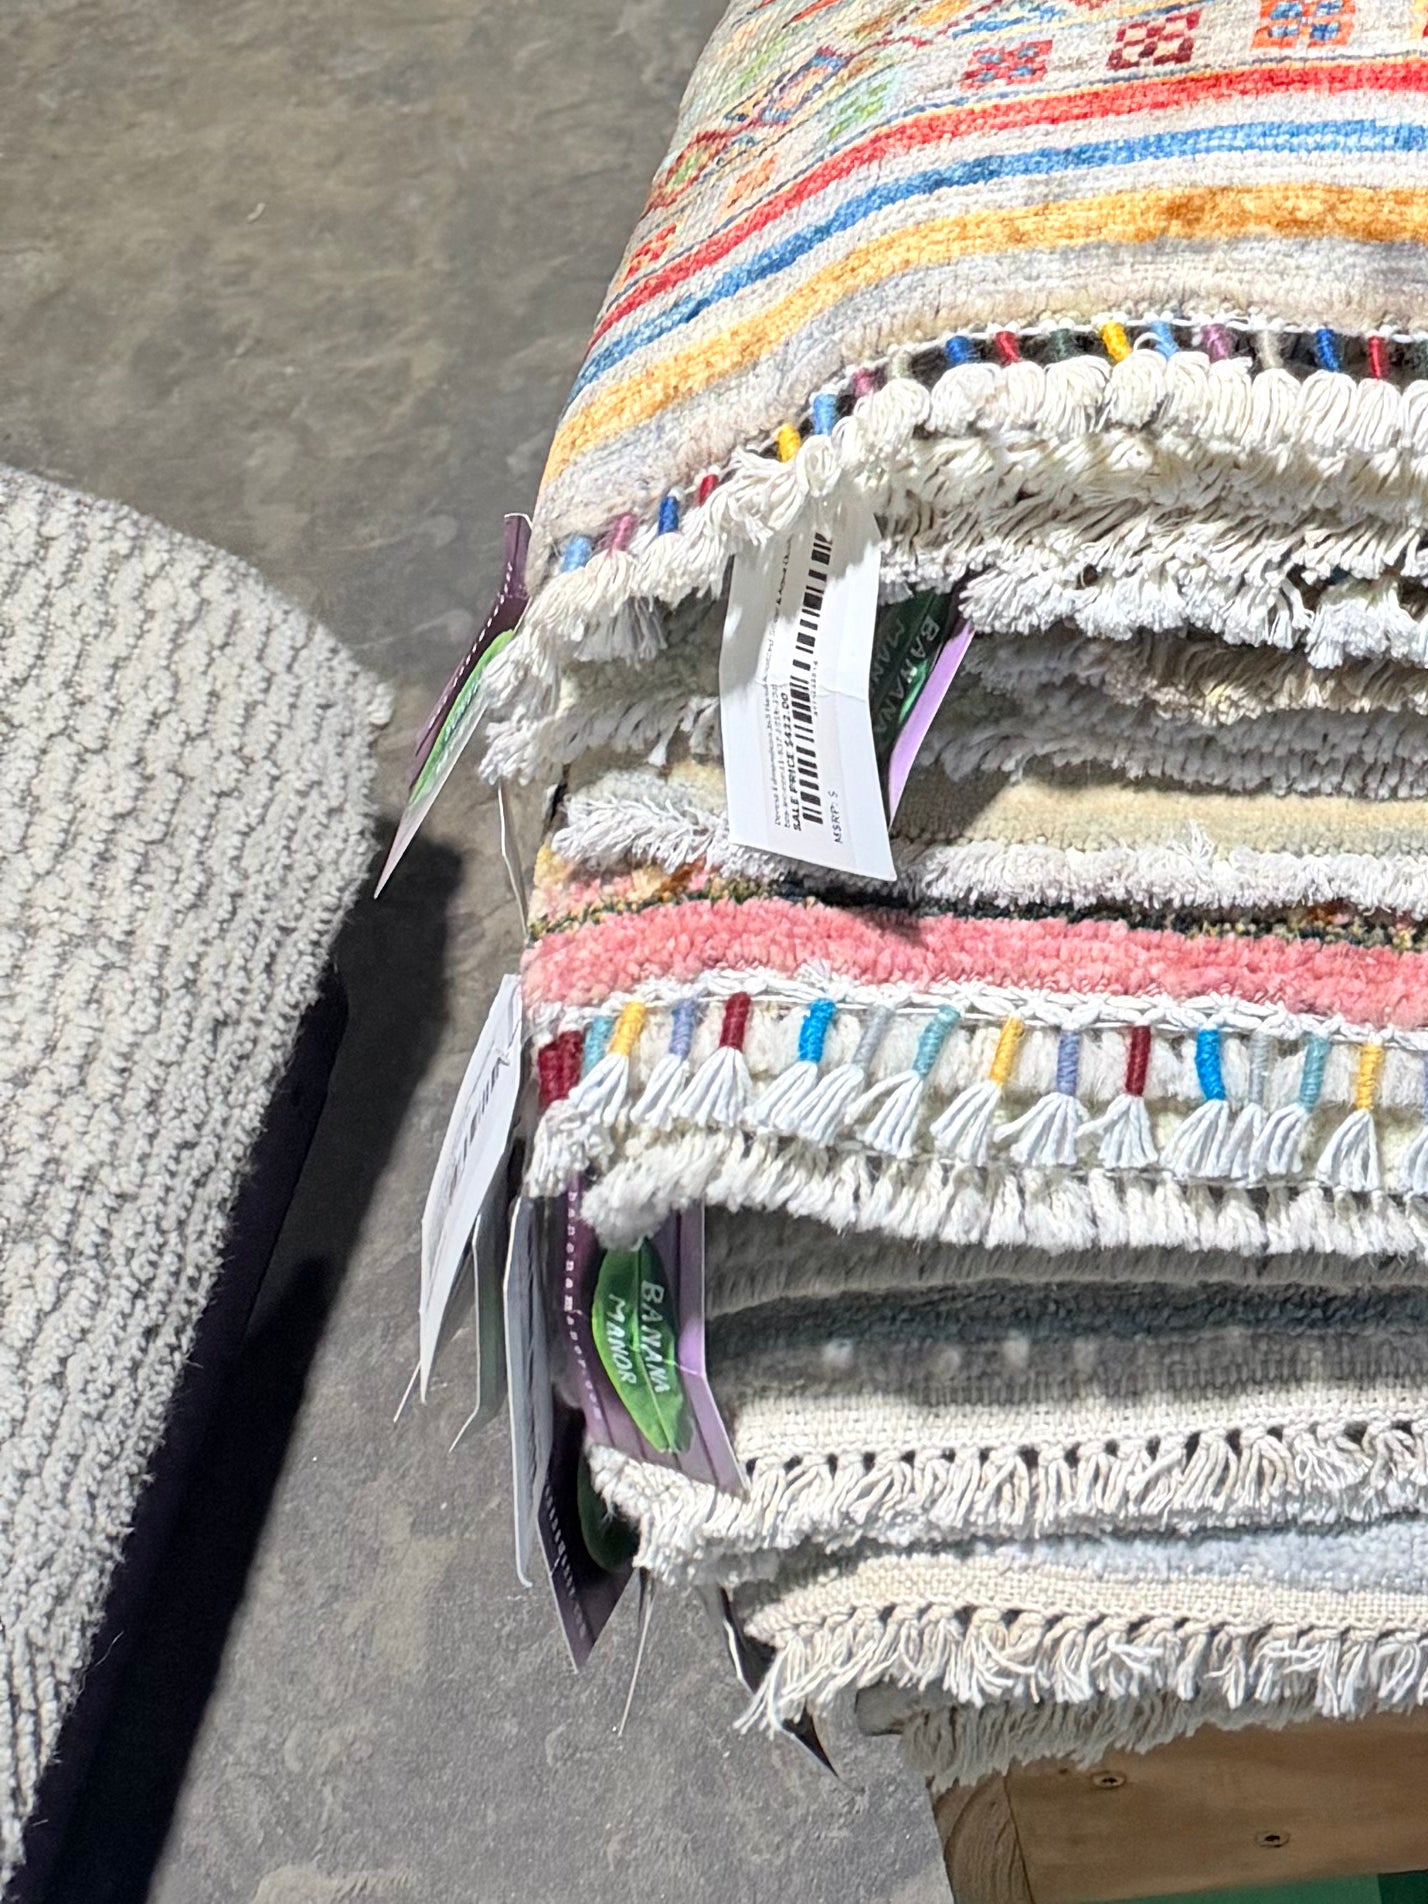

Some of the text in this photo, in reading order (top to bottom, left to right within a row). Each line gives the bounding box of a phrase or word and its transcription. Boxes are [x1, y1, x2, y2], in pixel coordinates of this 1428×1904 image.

[875, 616, 940, 733] BANANA
[787, 747, 799, 795] PRICE
[793, 795, 803, 832] SALE
[606, 1293, 638, 1384] MANOR
[640, 1279, 672, 1393] BANANA
